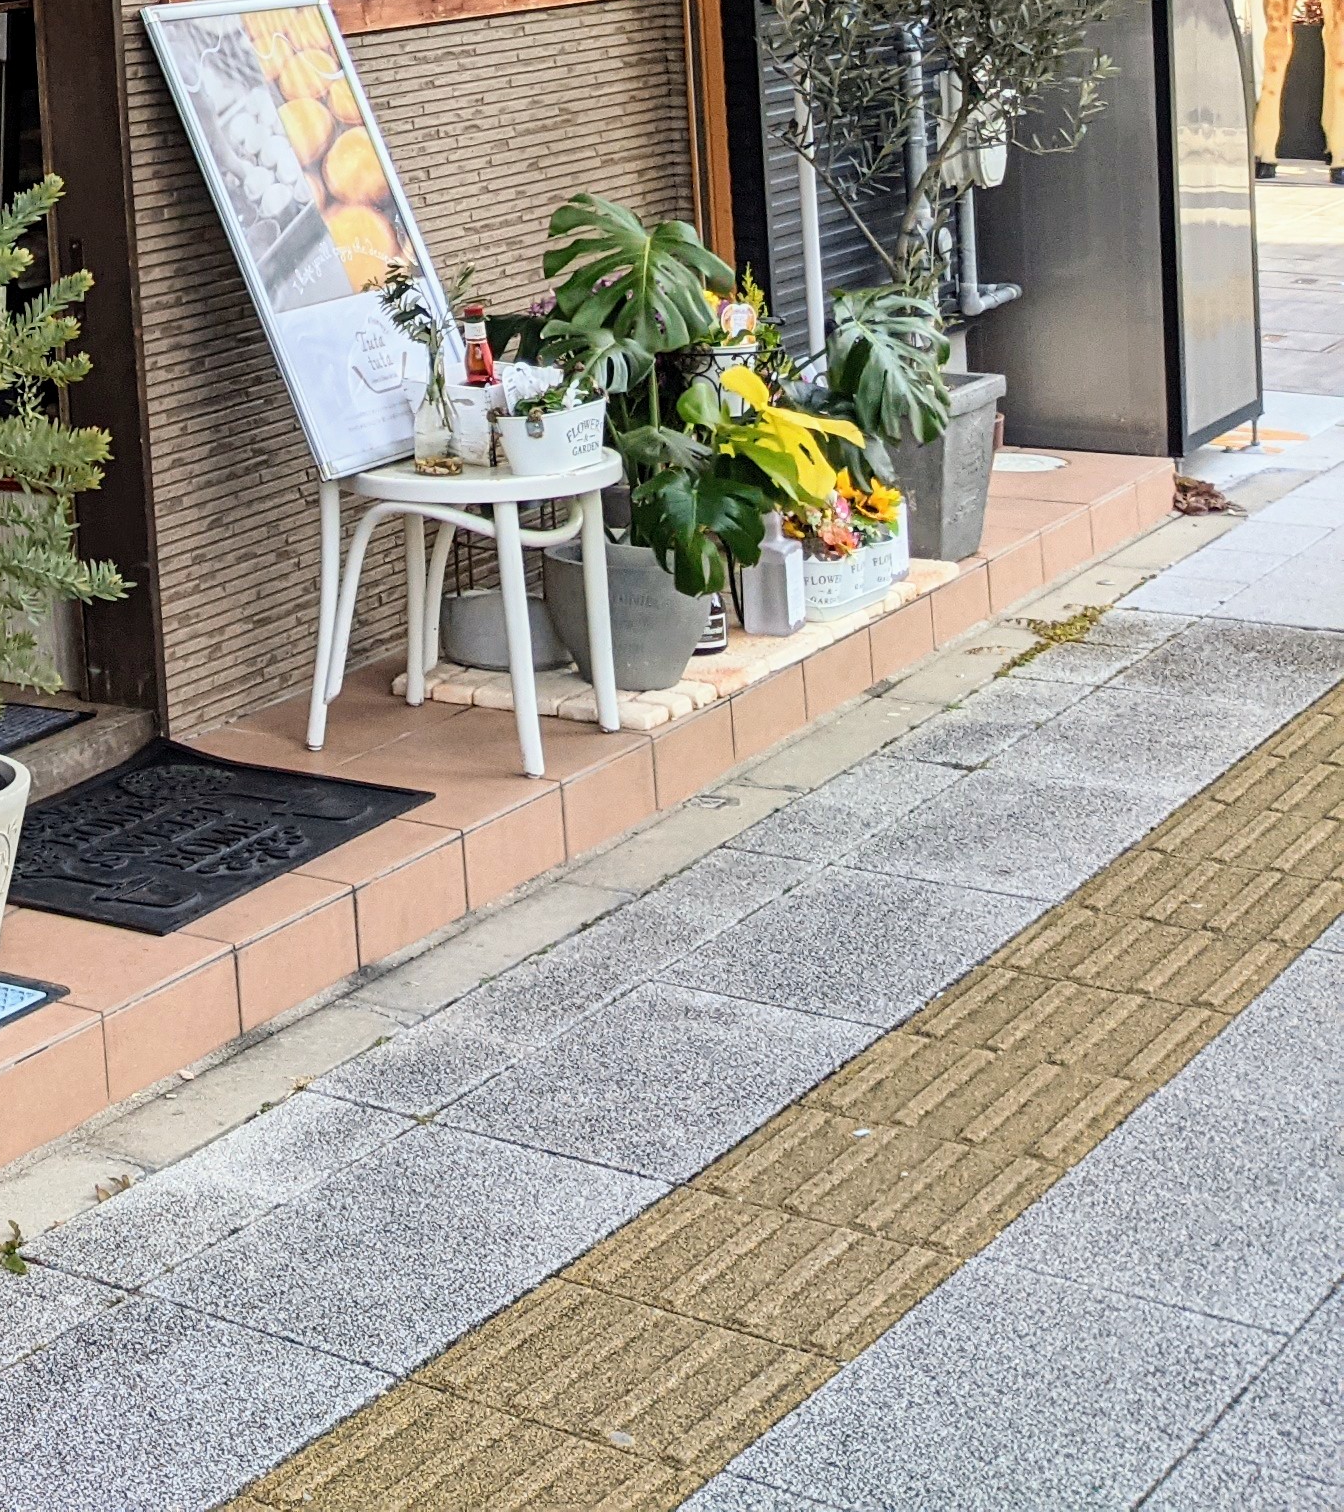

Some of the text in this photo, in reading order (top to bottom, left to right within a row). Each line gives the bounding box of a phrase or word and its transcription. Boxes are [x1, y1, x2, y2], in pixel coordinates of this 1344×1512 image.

[355, 331, 385, 352] Tuta
[368, 352, 394, 370] tuta
[572, 441, 600, 456] GARDEN
